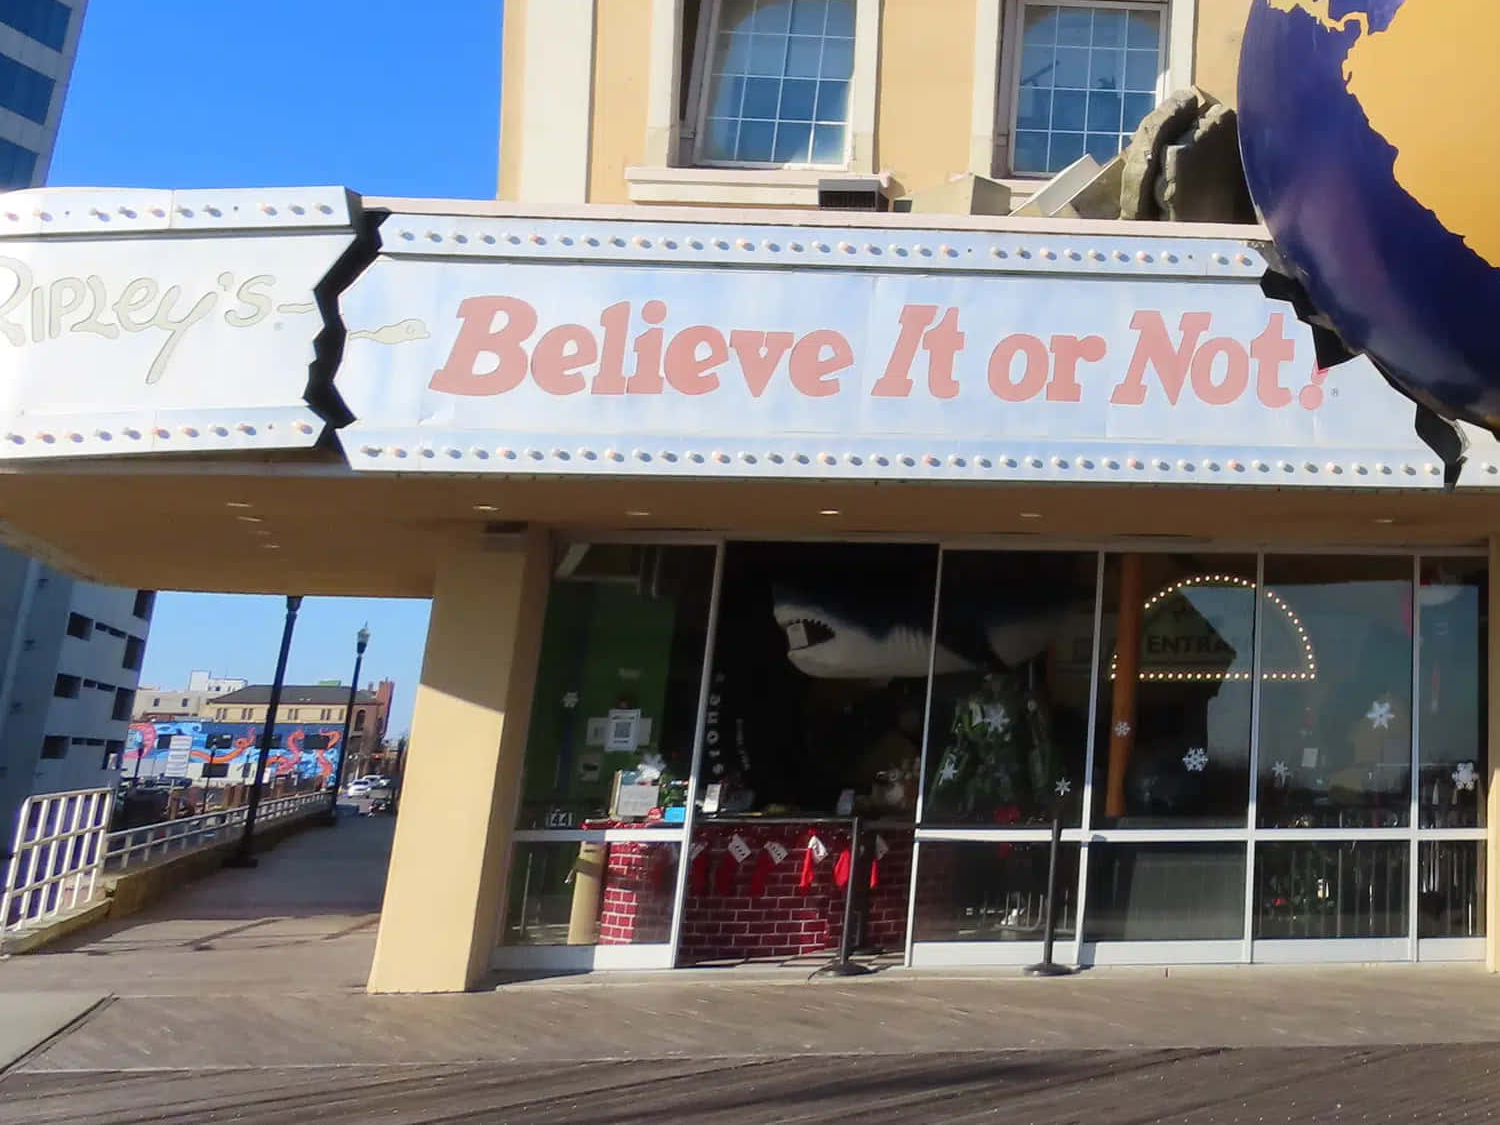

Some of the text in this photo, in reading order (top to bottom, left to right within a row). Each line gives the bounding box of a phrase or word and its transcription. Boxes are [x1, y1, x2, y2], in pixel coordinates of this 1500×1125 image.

[428, 295, 855, 397] Believe
[871, 303, 965, 398] It
[987, 333, 1107, 402] or
